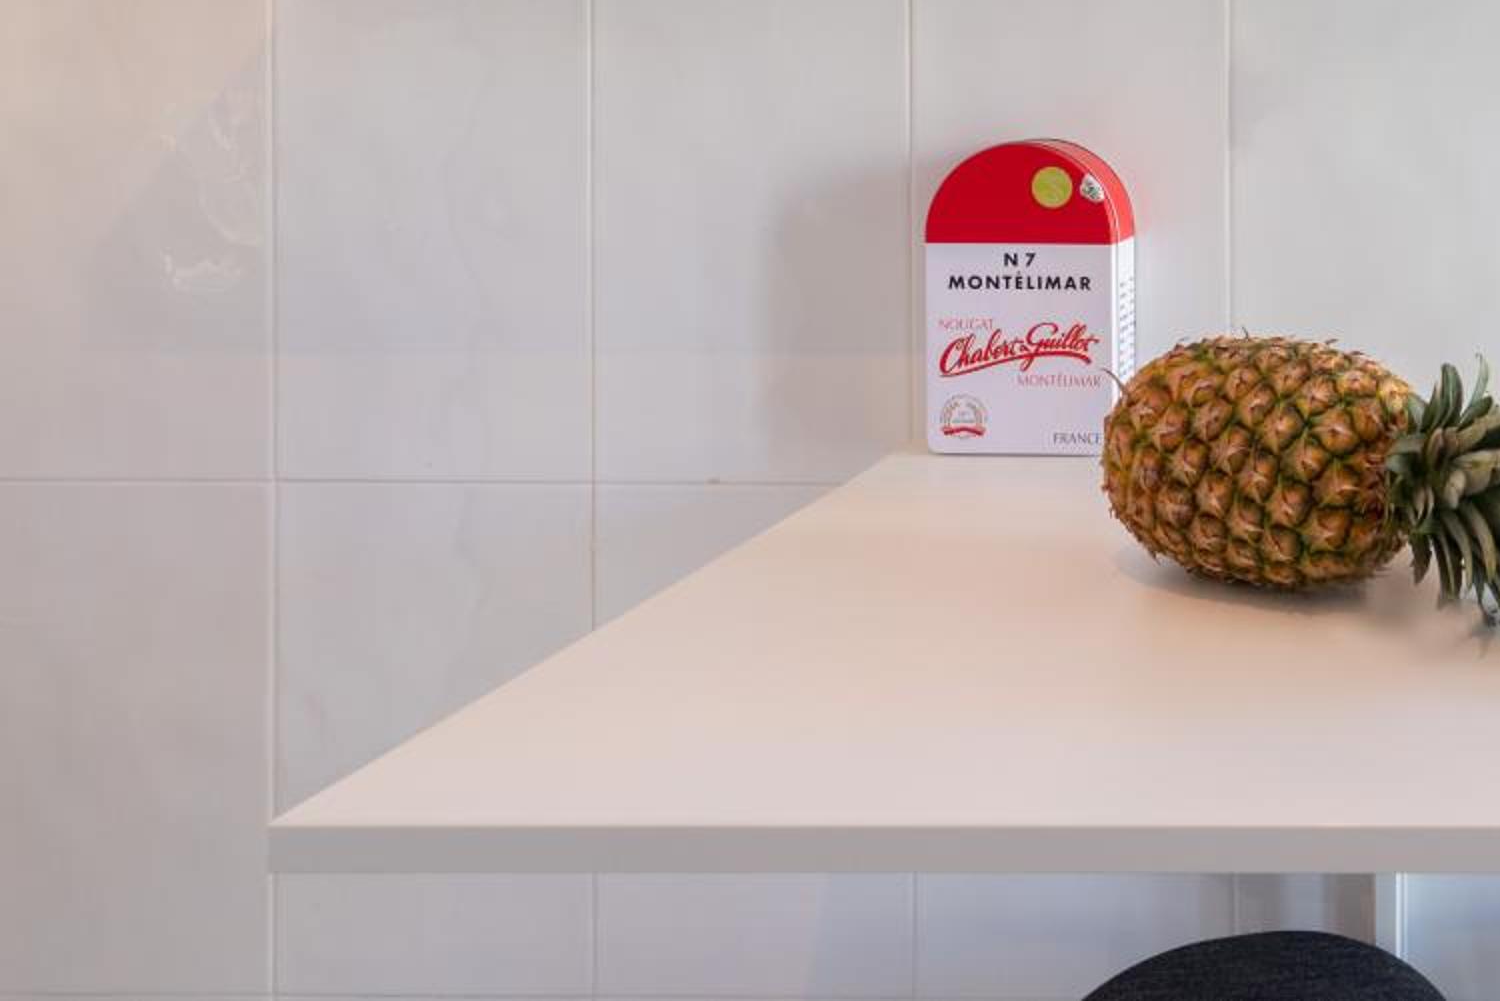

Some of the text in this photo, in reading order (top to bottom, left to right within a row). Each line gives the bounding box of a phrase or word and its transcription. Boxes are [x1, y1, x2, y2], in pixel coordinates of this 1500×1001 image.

[1003, 252, 1036, 267] N 7
[948, 271, 1091, 291] MONTÉLIMAR
[938, 318, 993, 331] NOUGAT
